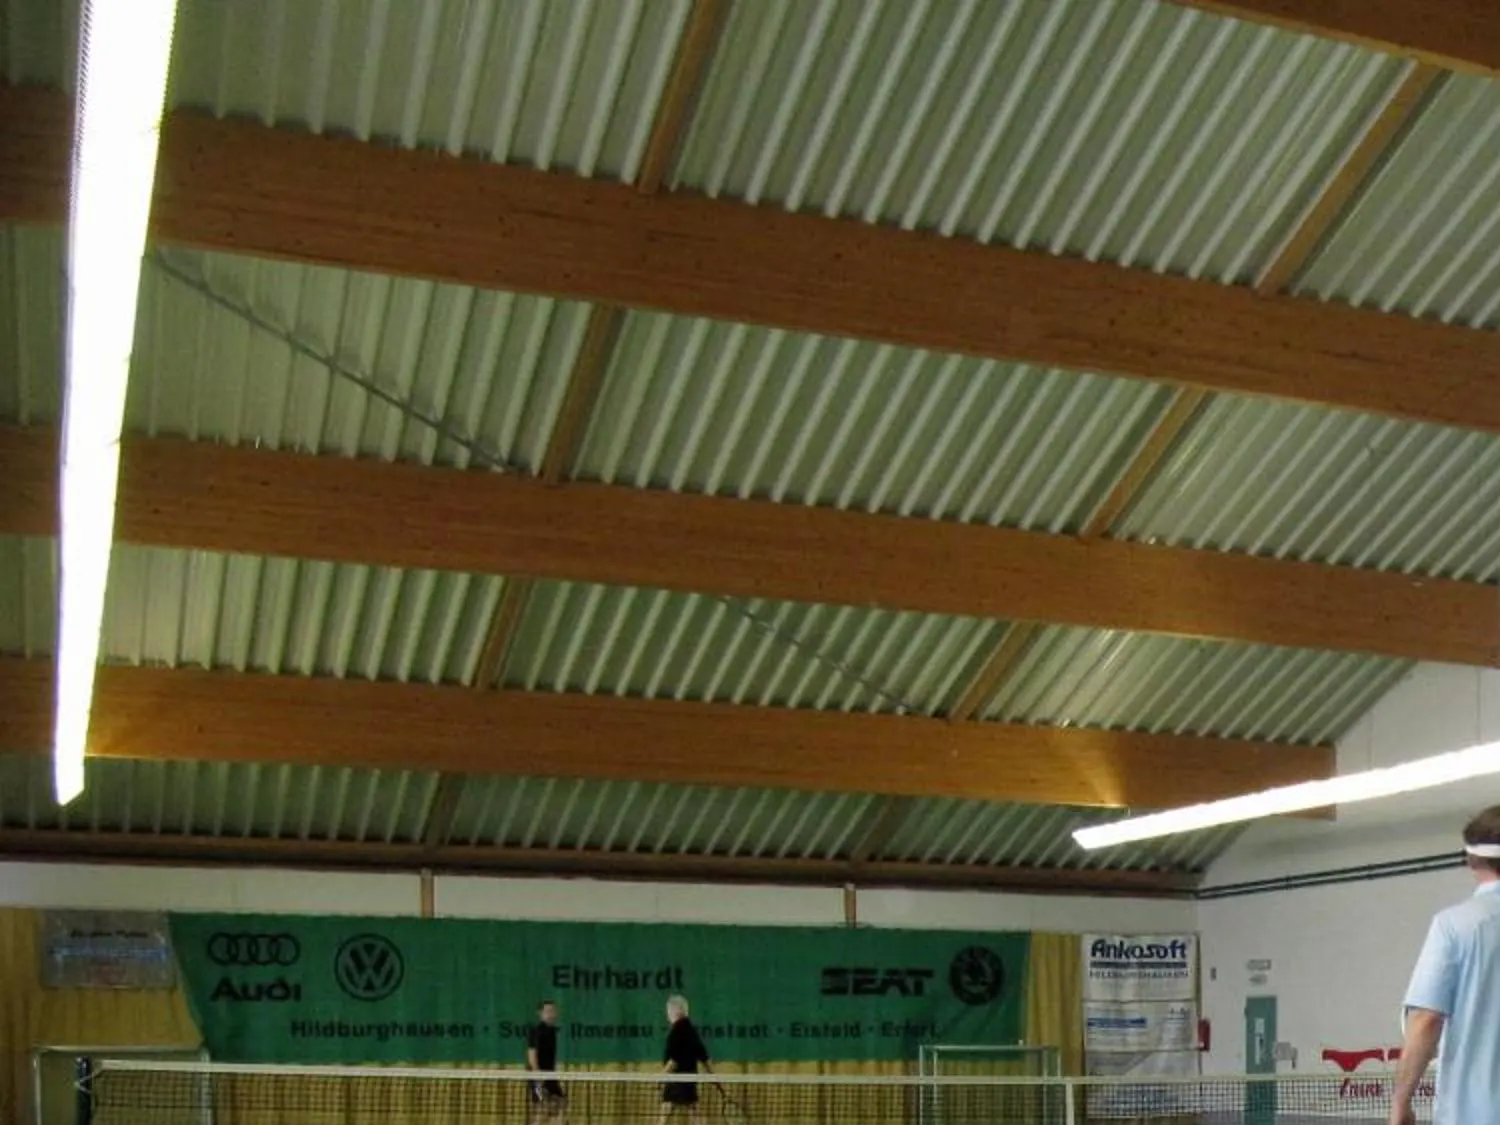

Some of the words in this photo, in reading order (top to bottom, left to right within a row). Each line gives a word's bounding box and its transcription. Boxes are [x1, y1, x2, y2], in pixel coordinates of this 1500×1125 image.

[1090, 938, 1187, 959] Ankosoft
[210, 975, 302, 1002] Audi
[551, 964, 684, 991] Ehrhardt
[820, 967, 934, 996] SEAT
[290, 1020, 475, 1042] Hildburghausen
